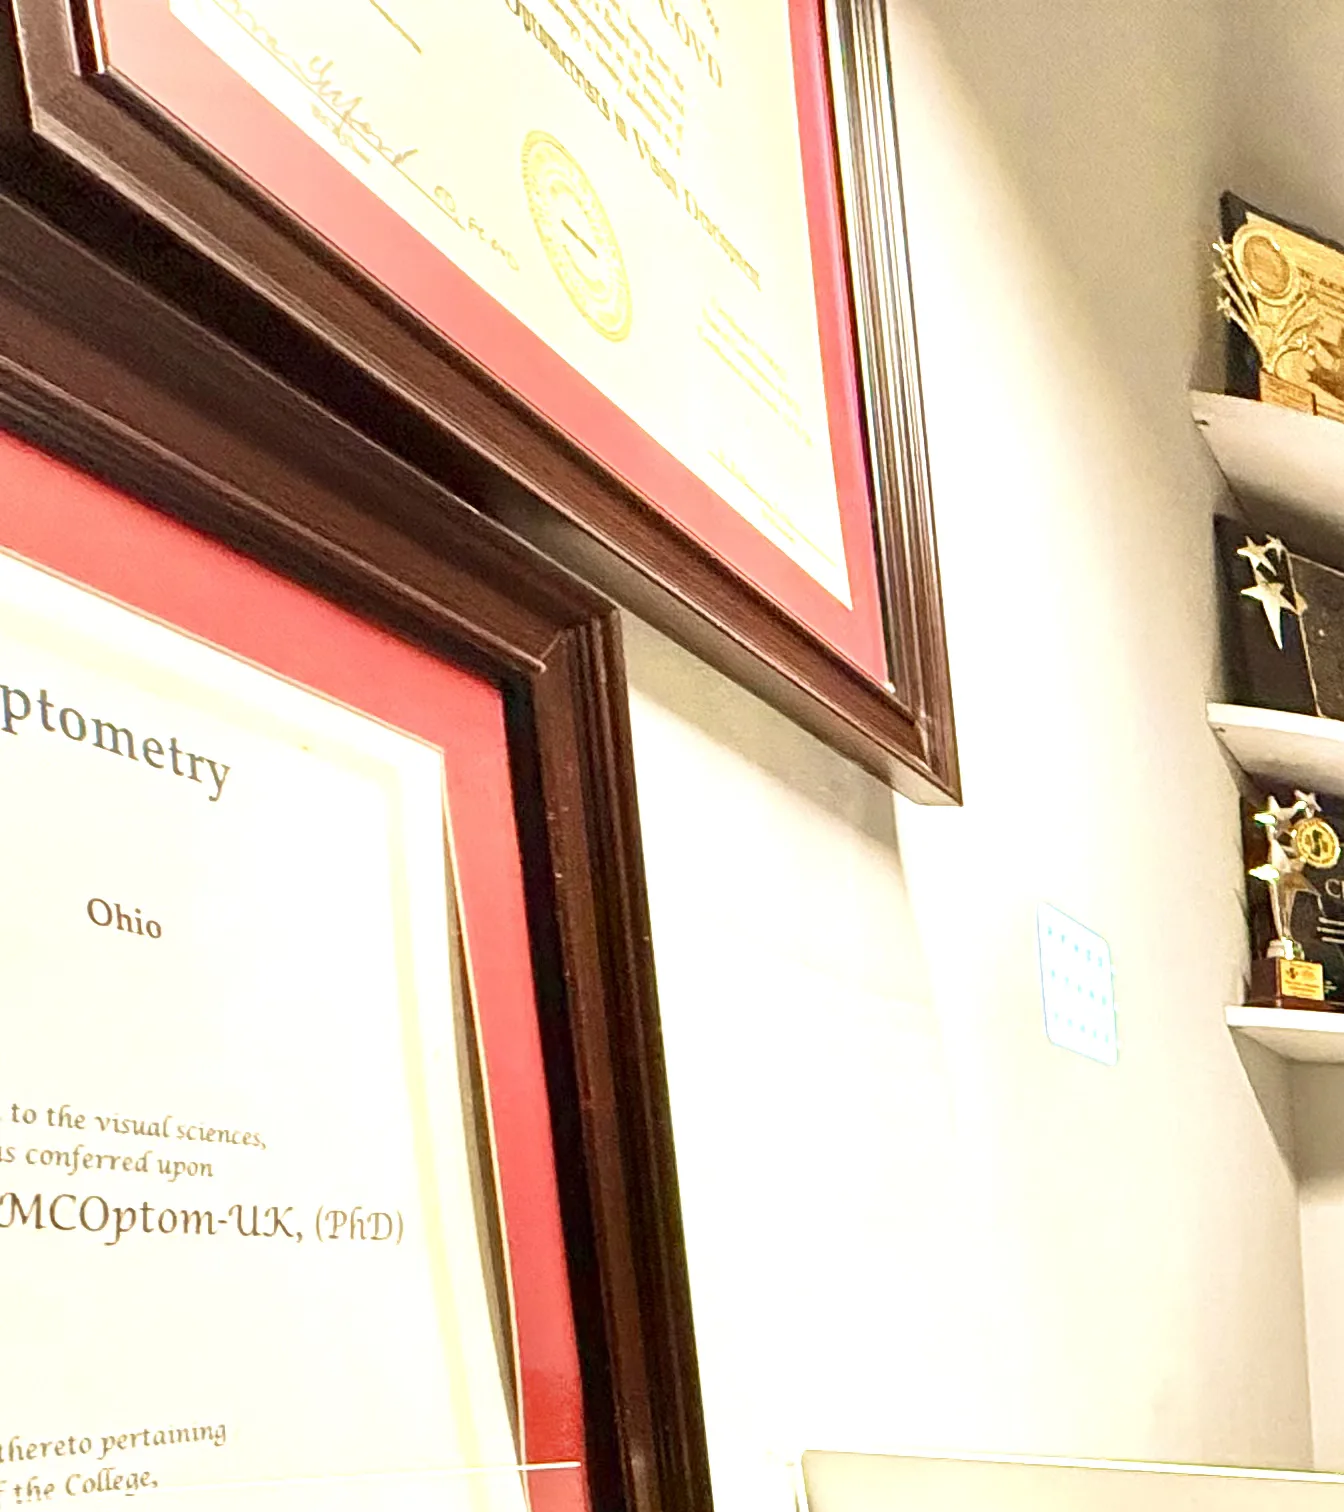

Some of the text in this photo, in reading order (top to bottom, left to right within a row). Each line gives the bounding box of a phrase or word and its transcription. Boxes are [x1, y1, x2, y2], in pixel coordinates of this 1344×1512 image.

[87, 898, 163, 939] Ohio
[11, 1103, 267, 1150] to the visual sciences,
[26, 1144, 214, 1183] conferred upon
[316, 1205, 404, 1245] (PhD)
[97, 1423, 226, 1460] pertaining
[14, 1467, 158, 1504] the College,
